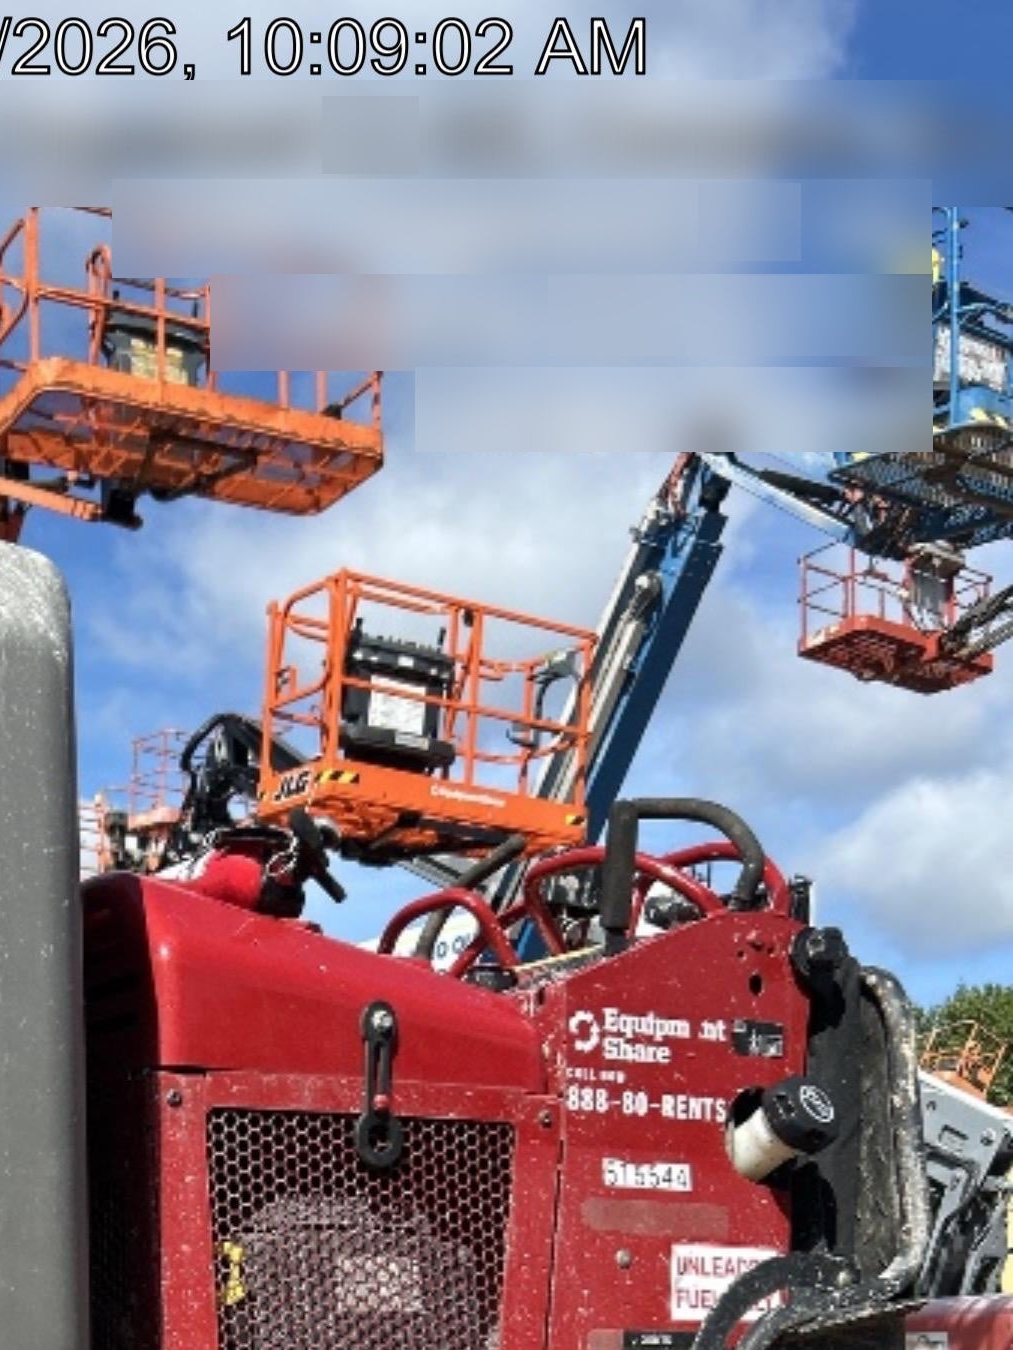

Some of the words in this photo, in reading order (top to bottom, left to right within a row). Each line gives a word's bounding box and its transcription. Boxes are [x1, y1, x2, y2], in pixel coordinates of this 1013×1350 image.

[602, 1008, 727, 1042] Equipmnt
[603, 1037, 672, 1063] Share
[567, 1085, 728, 1123] 888-80-RENTS
